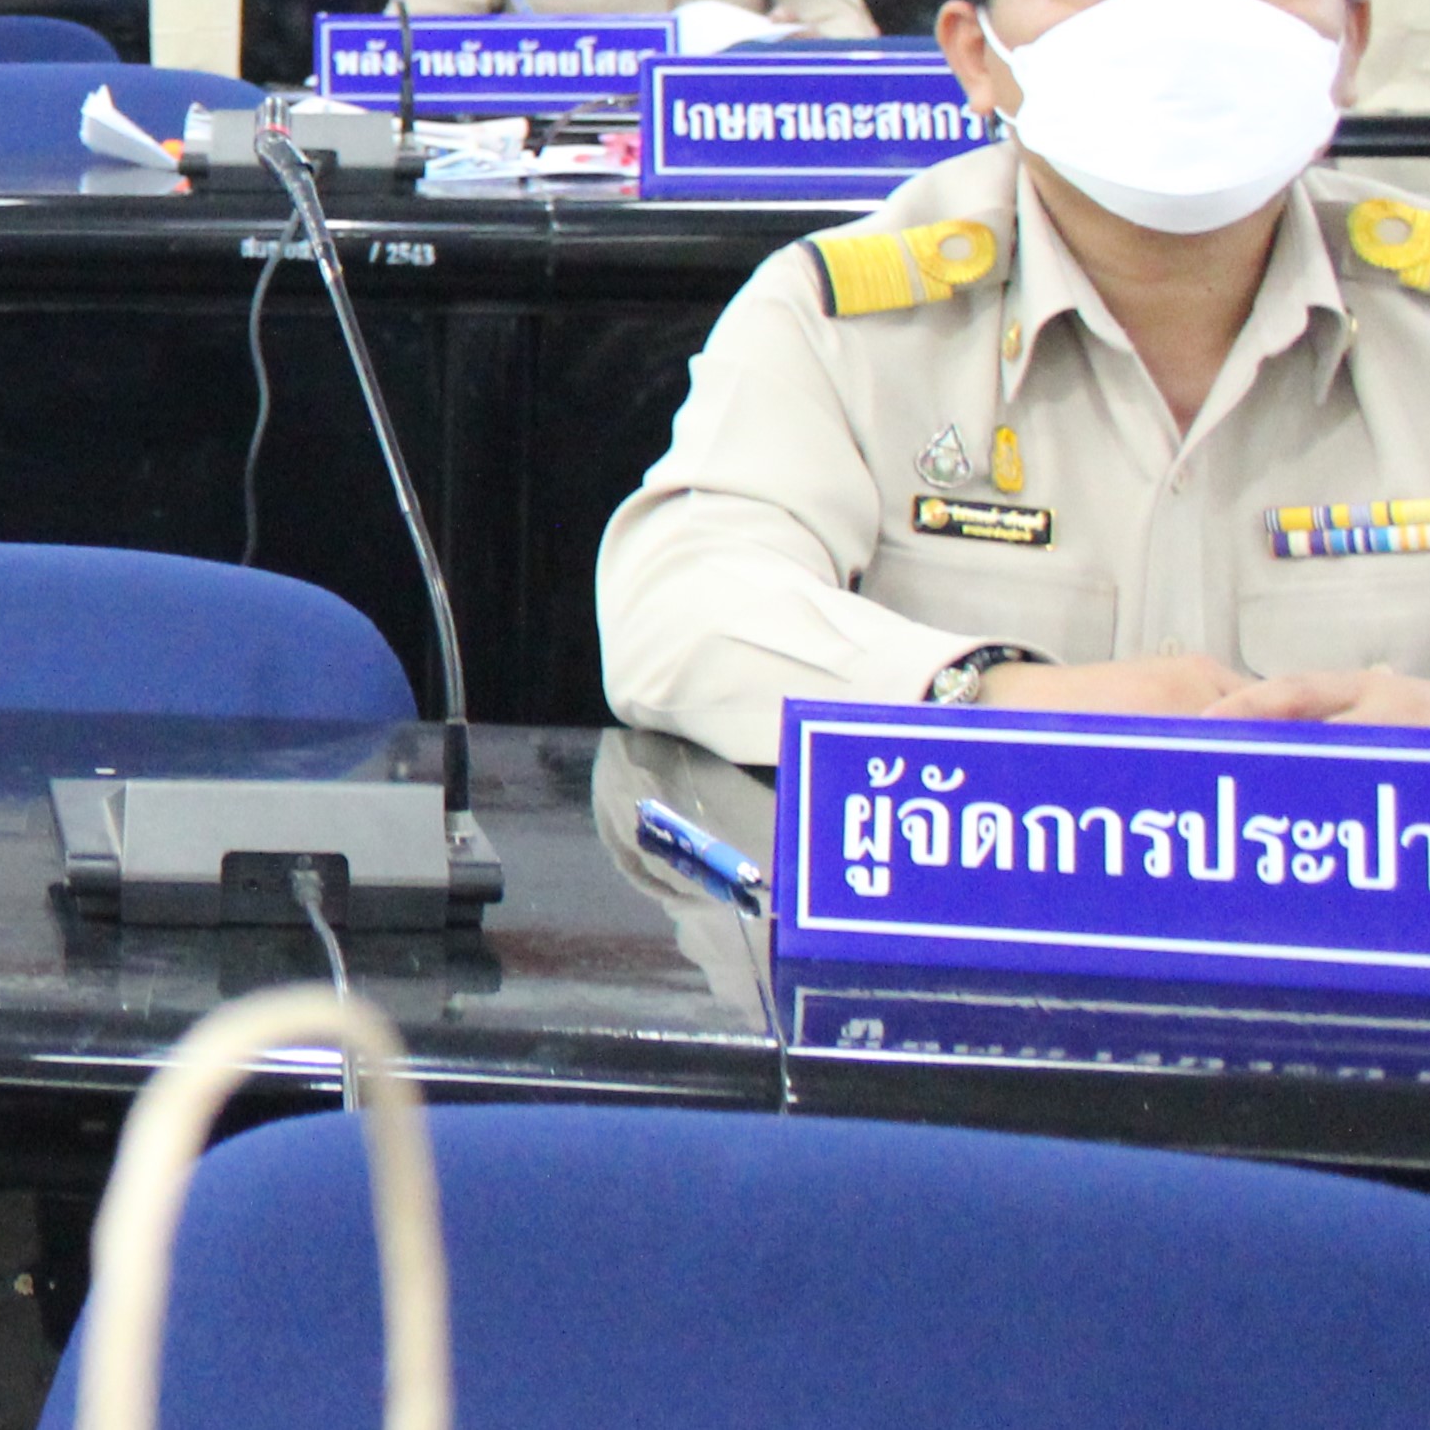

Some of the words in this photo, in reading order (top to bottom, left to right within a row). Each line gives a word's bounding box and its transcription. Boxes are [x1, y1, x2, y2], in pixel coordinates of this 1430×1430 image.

[334, 36, 656, 76] พลังานจังหวัดยโสธ
[673, 99, 987, 141] เกษตรและสหกร
